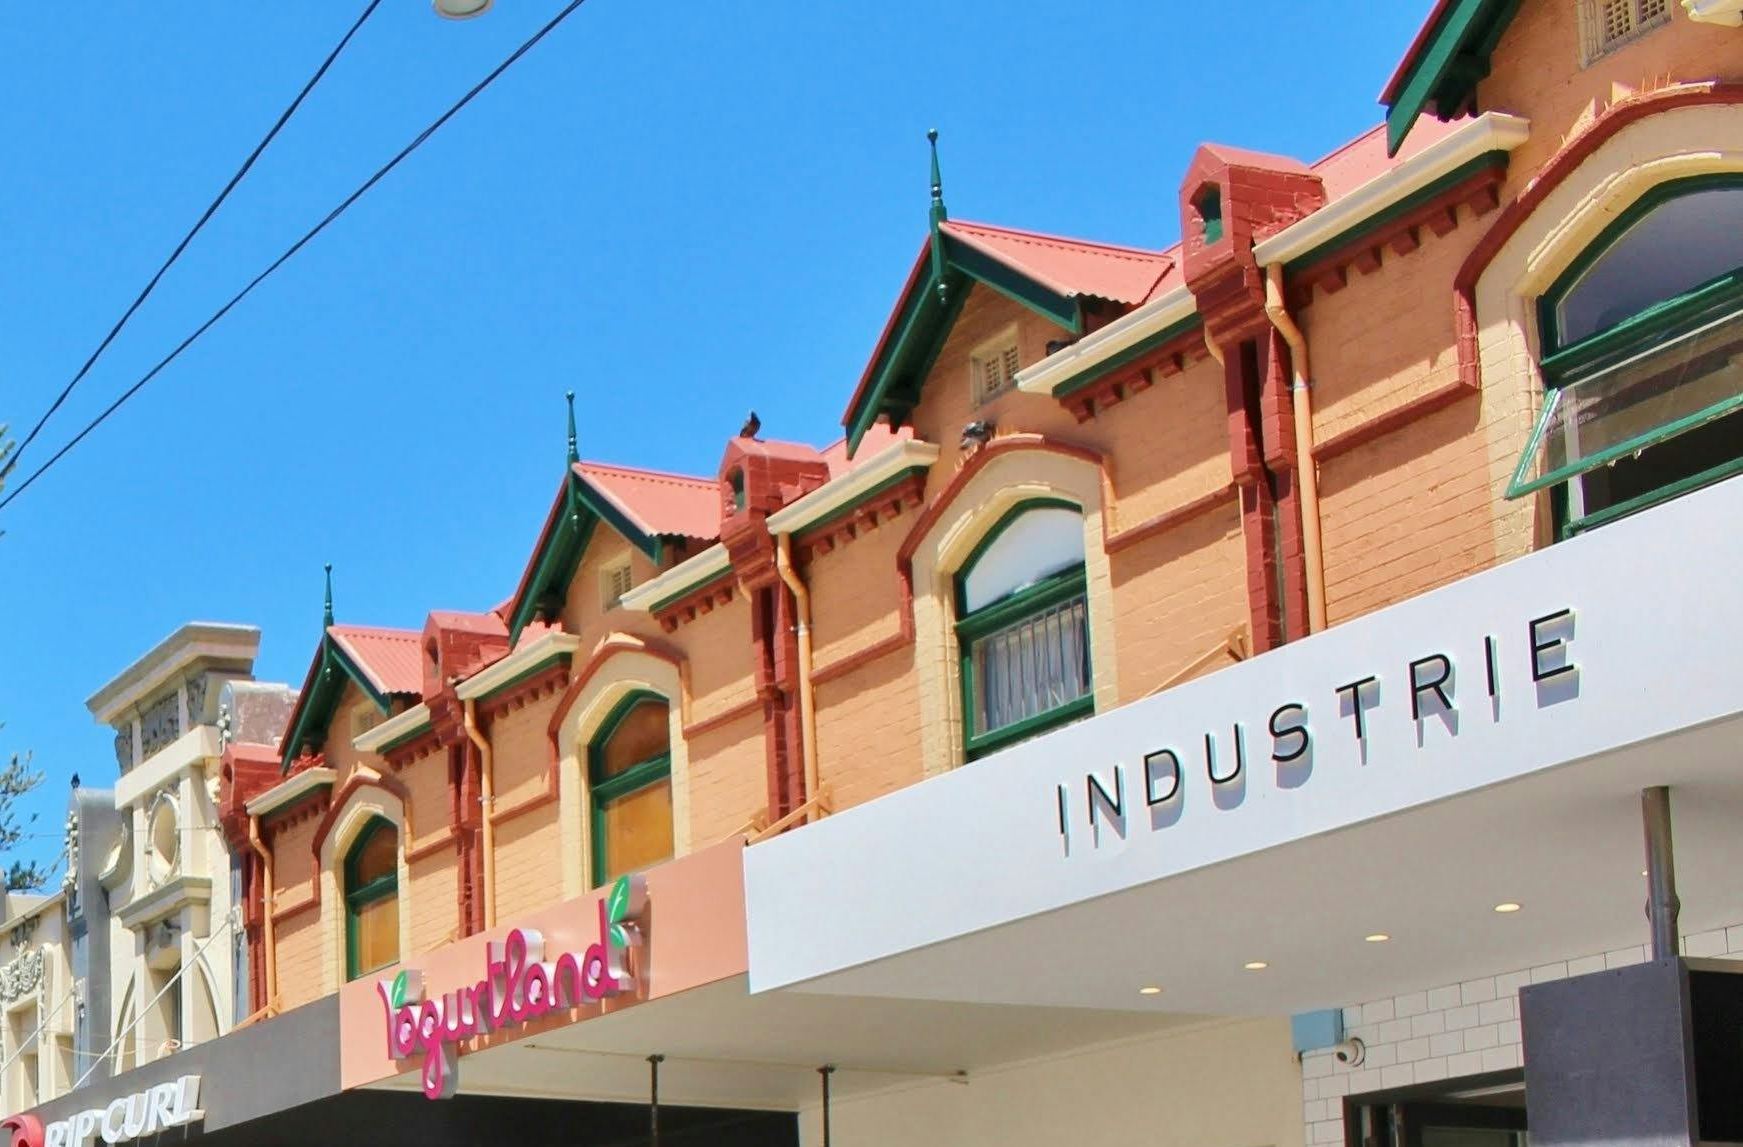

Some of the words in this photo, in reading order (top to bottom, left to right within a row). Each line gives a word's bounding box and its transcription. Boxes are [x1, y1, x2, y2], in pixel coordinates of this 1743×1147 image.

[1057, 608, 1576, 835] INDUSTRIE
[377, 897, 622, 1100] Yogurtland
[100, 1074, 206, 1146] CURL
